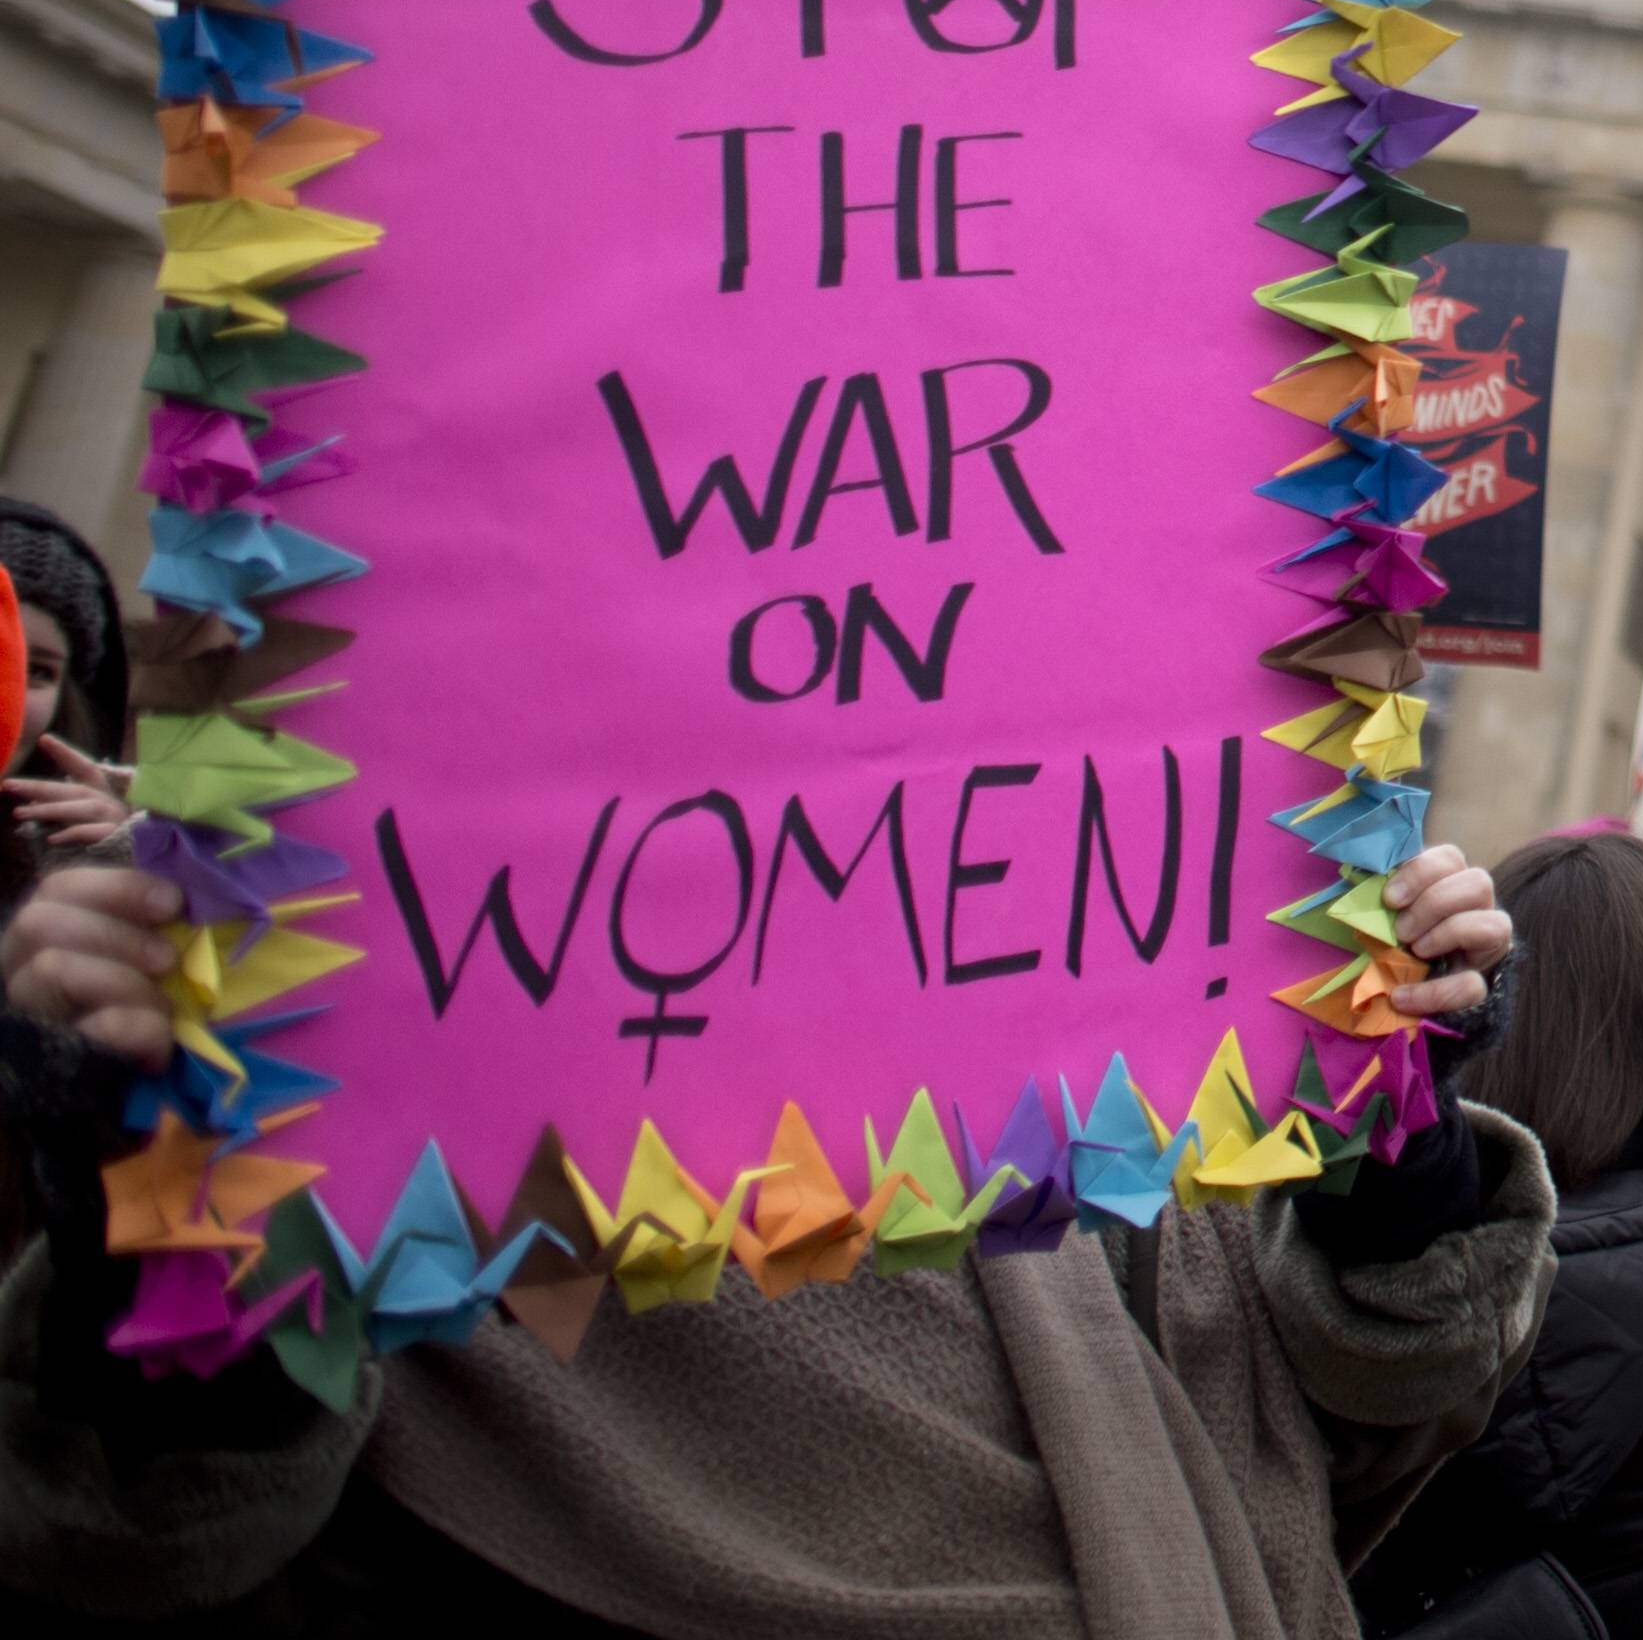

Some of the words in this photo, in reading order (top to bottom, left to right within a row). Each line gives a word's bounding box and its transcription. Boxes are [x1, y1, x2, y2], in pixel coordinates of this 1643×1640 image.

[677, 125, 1023, 292] THE
[599, 359, 1065, 560] WAR
[728, 582, 975, 705] ON
[375, 736, 1243, 1085] WOMEN!
